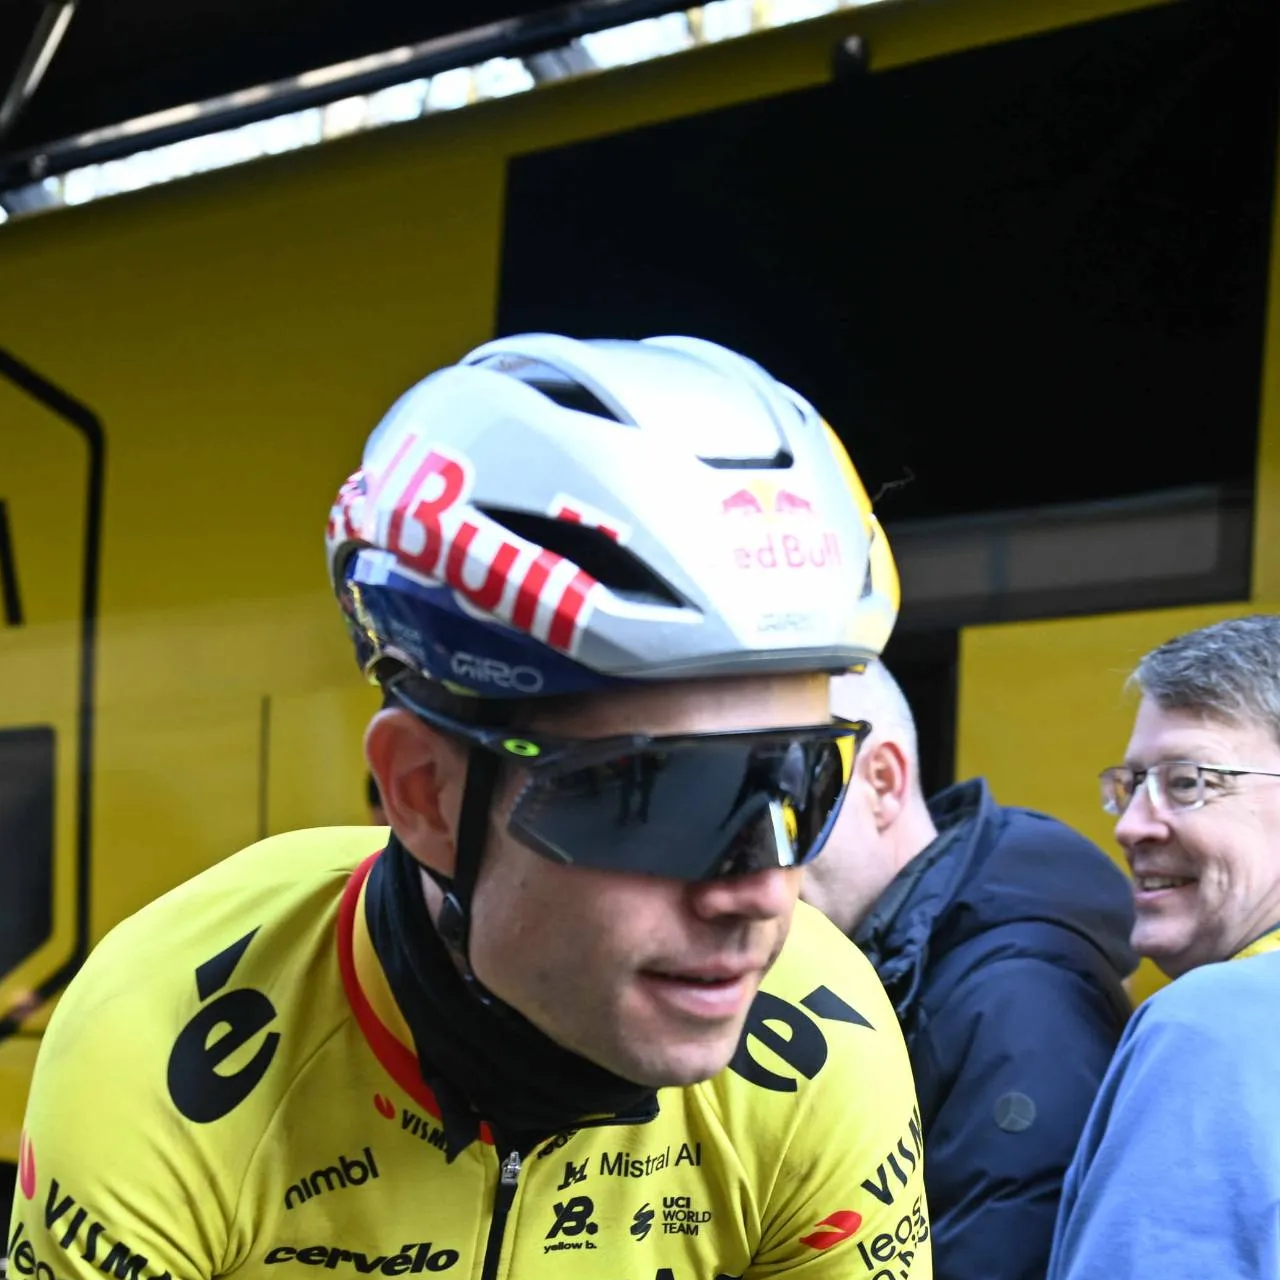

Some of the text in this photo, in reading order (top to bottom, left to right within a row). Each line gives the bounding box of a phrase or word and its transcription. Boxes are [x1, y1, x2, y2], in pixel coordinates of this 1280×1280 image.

[450, 652, 544, 694] GIRO
[599, 1146, 670, 1179] Mistral
[674, 1142, 702, 1168] AI
[285, 1146, 379, 1210] nimbl
[662, 1197, 691, 1209] UCI
[662, 1210, 712, 1224] WORLD
[661, 1223, 700, 1236] TEAM
[264, 1242, 460, 1277] cervélo
[544, 1242, 584, 1254] yellow
